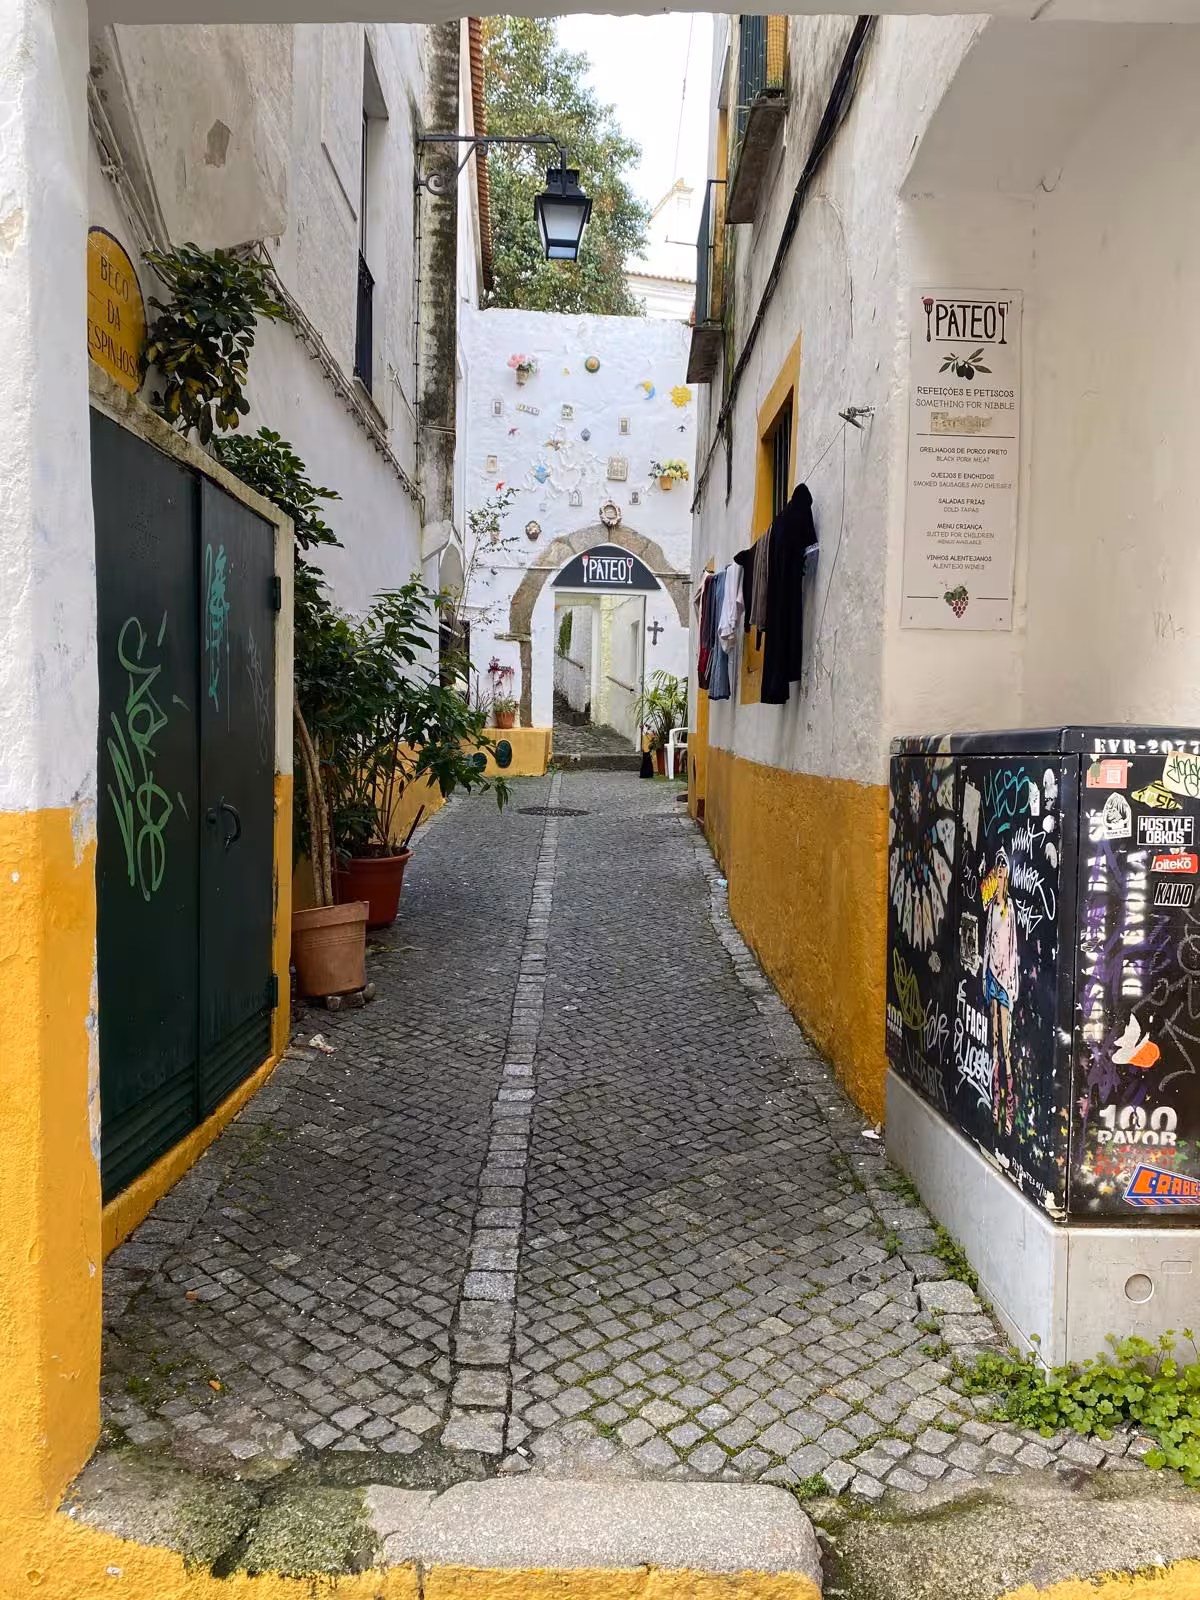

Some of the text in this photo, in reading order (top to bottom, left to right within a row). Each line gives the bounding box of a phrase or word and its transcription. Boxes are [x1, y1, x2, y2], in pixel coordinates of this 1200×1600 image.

[101, 256, 128, 303] BECO
[108, 299, 120, 331] DA
[936, 303, 996, 339] PÁTEO
[917, 386, 1014, 397] REFEIÇÕES E PETISCOS
[916, 399, 1015, 410] SOMETHING FOR NIBBLE
[920, 446, 955, 454] GRELHADOS
[589, 559, 626, 580] PÁTEO
[1140, 817, 1191, 832] HOSTYLE
[1154, 883, 1194, 907] KAINO
[1099, 1104, 1177, 1131] 100
